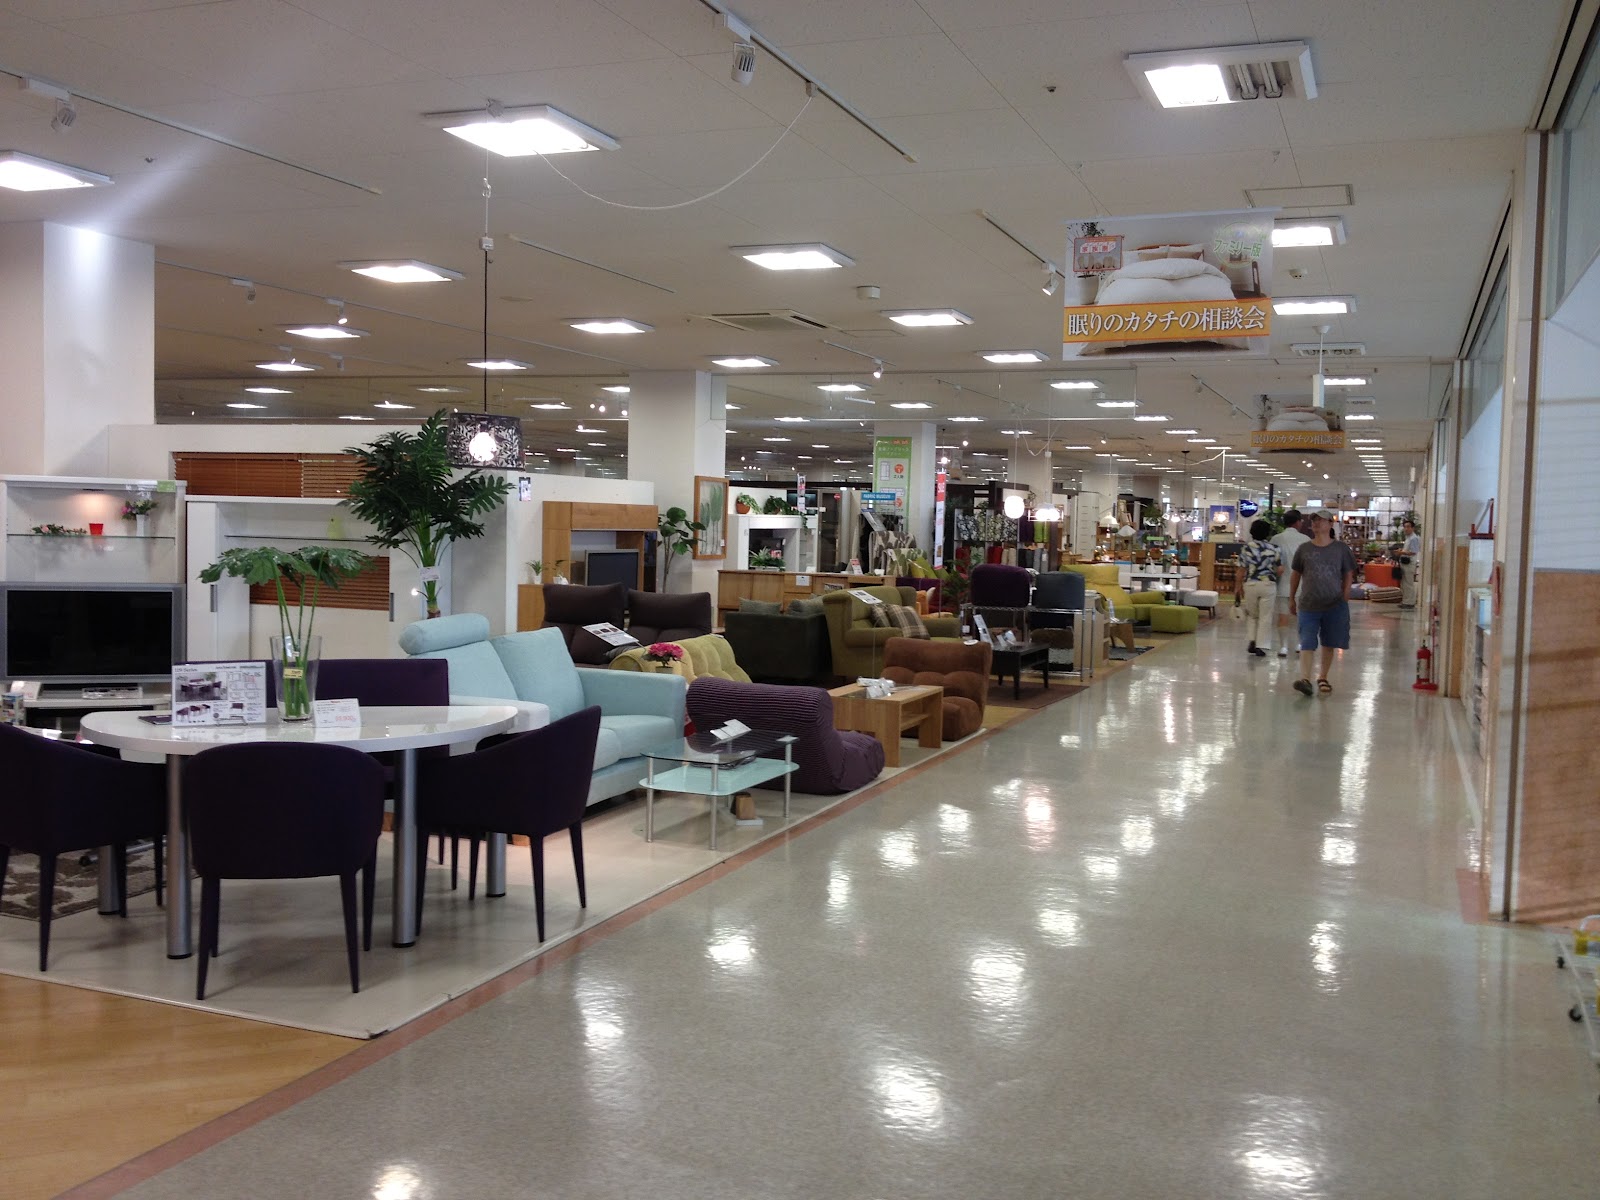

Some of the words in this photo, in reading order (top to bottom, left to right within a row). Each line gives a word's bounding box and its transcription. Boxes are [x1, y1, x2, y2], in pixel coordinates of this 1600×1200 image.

[1068, 305, 1266, 336] 眠りのカタチの相談会
